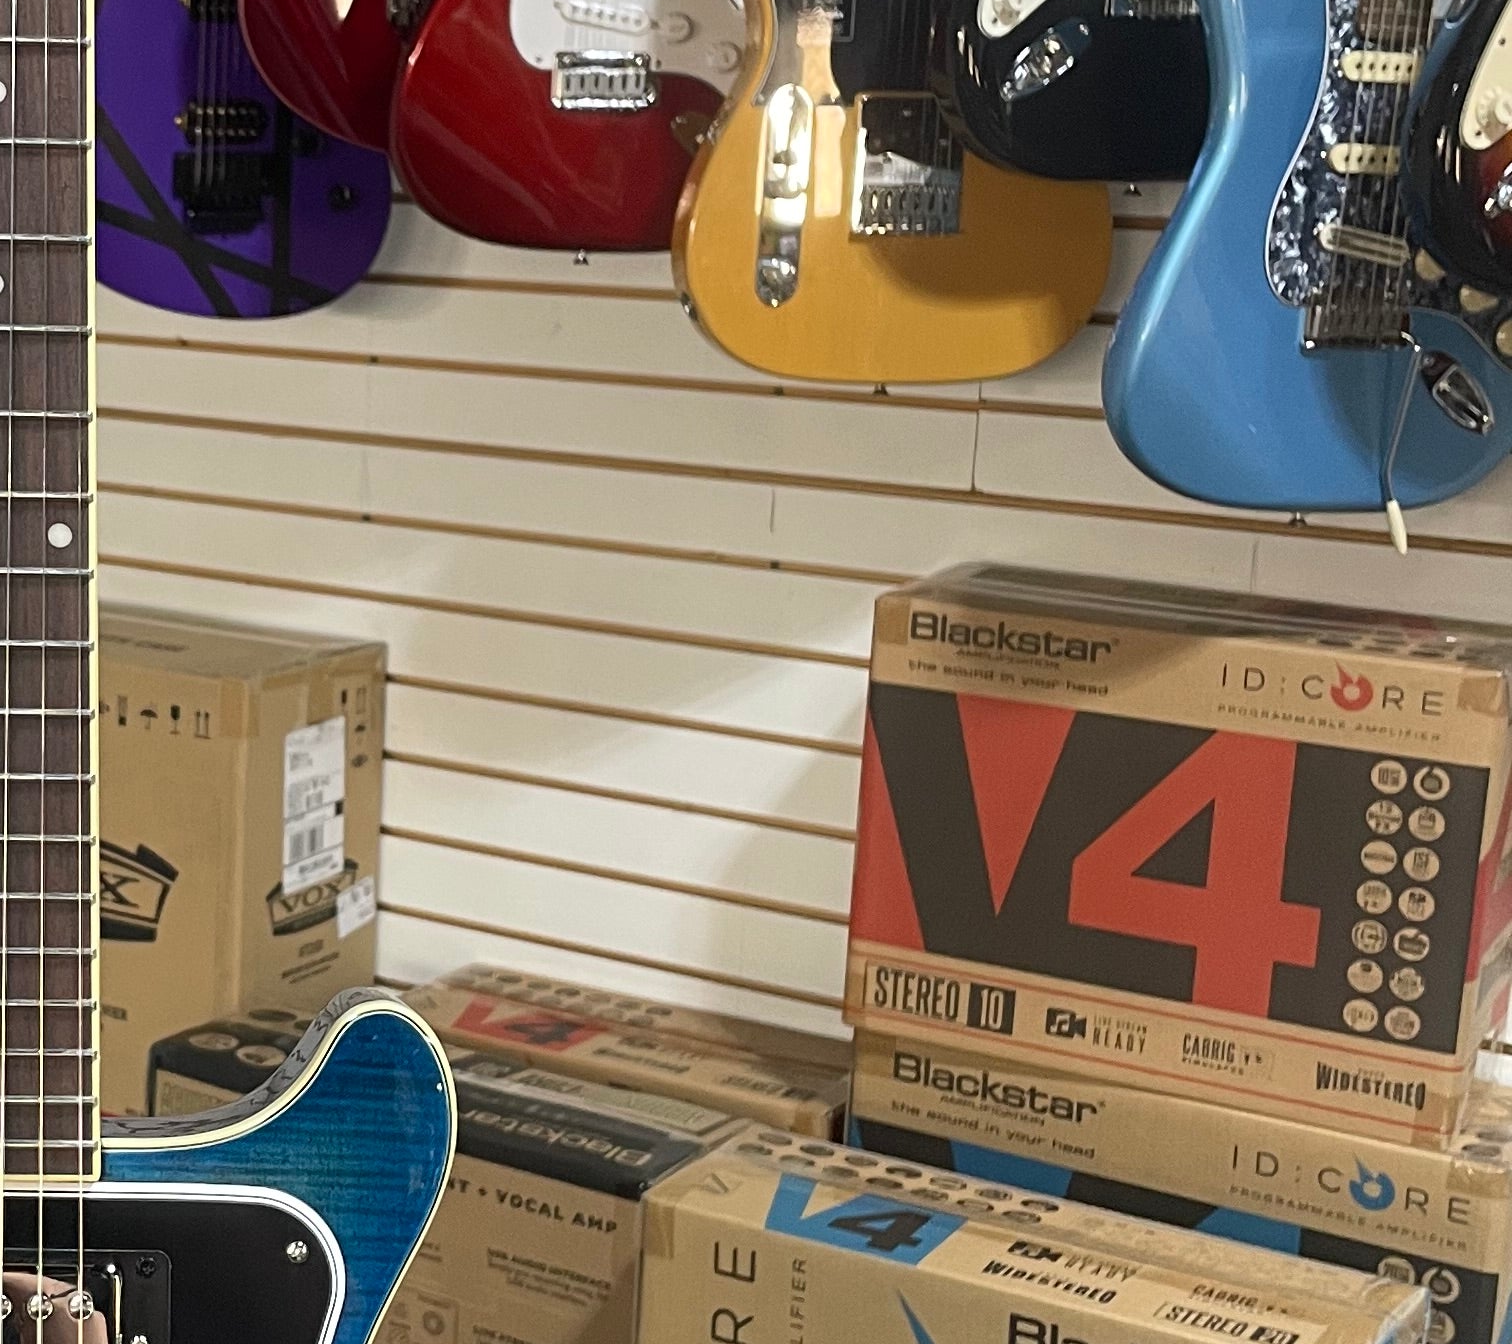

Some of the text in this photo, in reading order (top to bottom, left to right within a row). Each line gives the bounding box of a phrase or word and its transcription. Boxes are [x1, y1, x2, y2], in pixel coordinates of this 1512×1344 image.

[909, 611, 1114, 664] Blackstar
[868, 680, 1322, 1020] V4
[874, 965, 1005, 1030] STEREO 10
[1092, 1026, 1148, 1055] READY
[893, 1051, 1098, 1123] Blackstar
[1316, 1061, 1426, 1111] WIDESTEREO
[1052, 1138, 1096, 1159] head
[496, 1189, 565, 1221] VOCAL
[572, 1211, 618, 1234] AMP
[982, 1260, 1118, 1304] WIDESTEREO
[1165, 1305, 1249, 1338] STEREO
